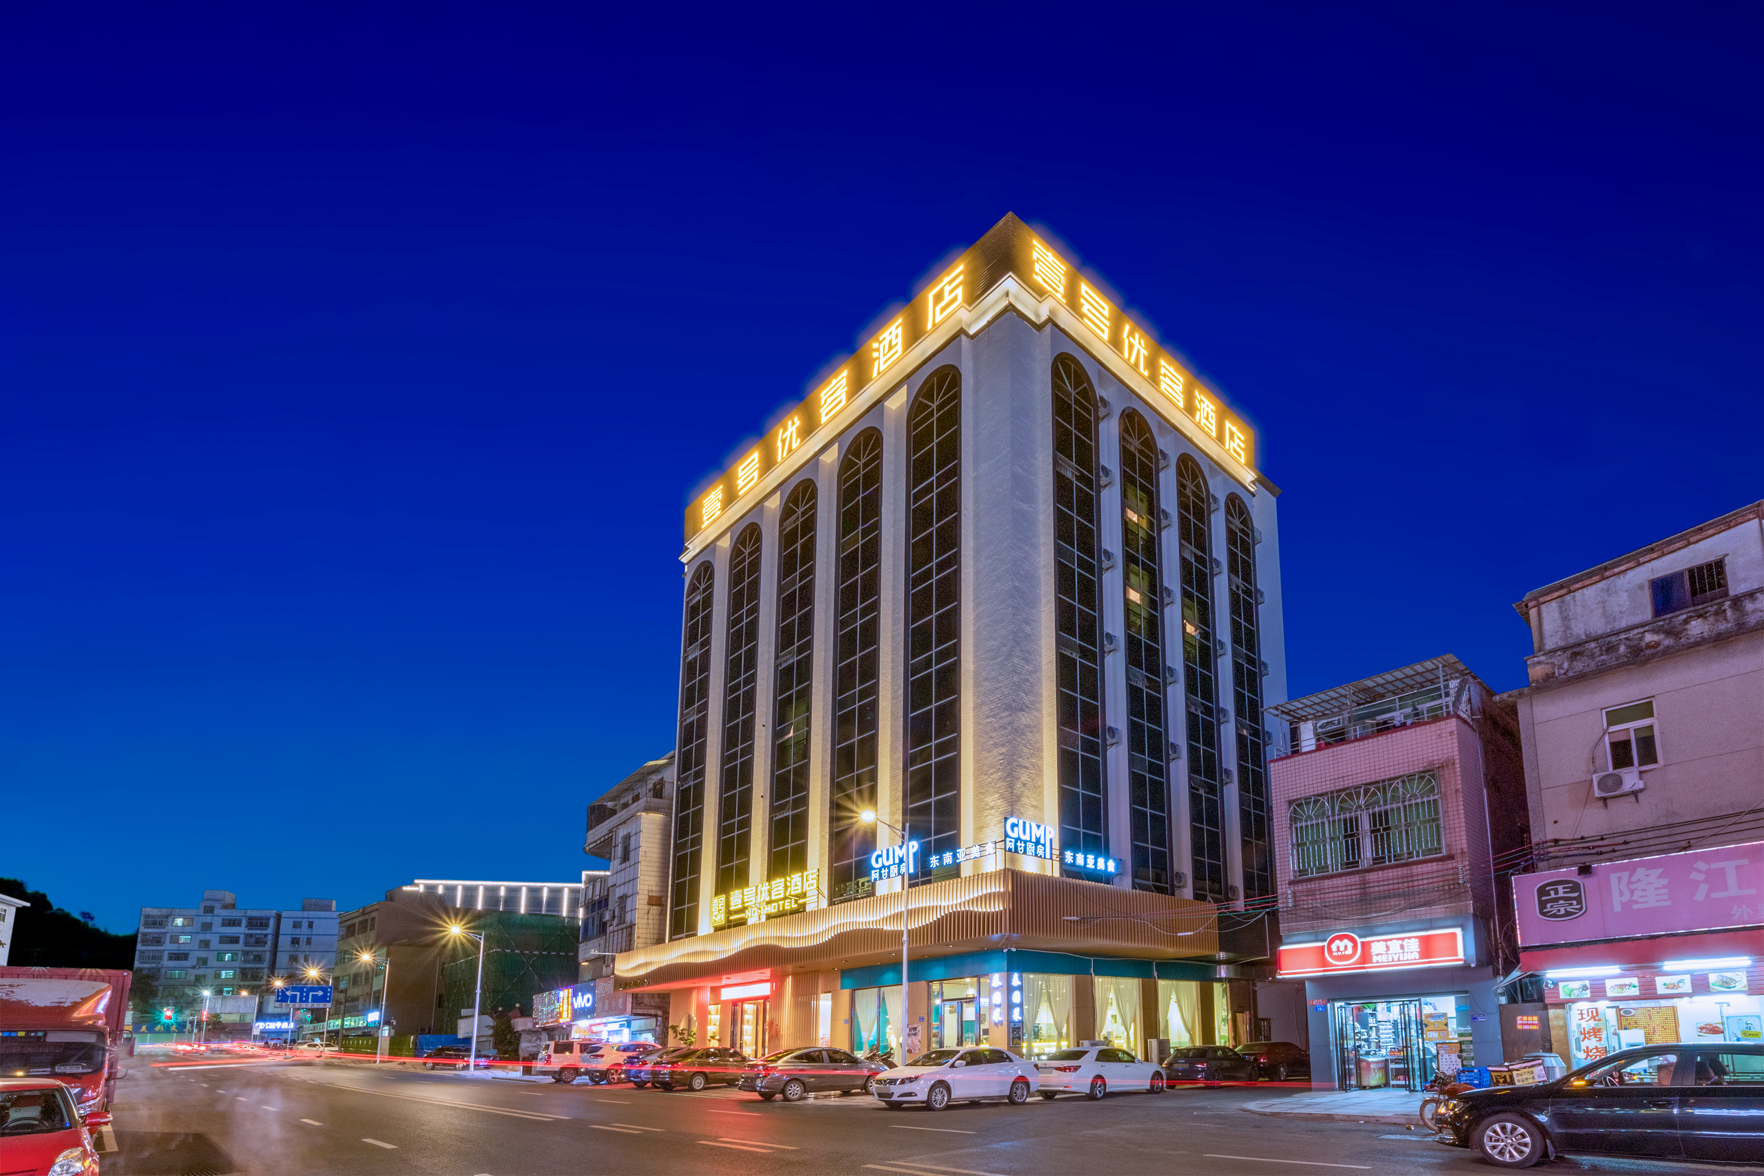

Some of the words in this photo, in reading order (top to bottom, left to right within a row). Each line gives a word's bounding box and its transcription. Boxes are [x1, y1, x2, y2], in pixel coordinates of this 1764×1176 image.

[1032, 239, 1246, 464] 壹号优客酒店
[701, 263, 965, 530] 壹号优客酒店
[929, 841, 996, 869] 东南亚美食
[1005, 817, 1055, 860] GUMP
[1006, 837, 1045, 859] 阿甘厨房
[871, 840, 919, 874] GUMP
[1065, 850, 1116, 873] 东南亚美食
[729, 868, 819, 911] 壹号优客酒店
[1541, 883, 1582, 916] 正宗
[1610, 858, 1758, 913] 隆江
[1370, 938, 1420, 955] 美宜佳
[1372, 951, 1420, 963] MEIYIJIA
[573, 992, 593, 1009] vivo
